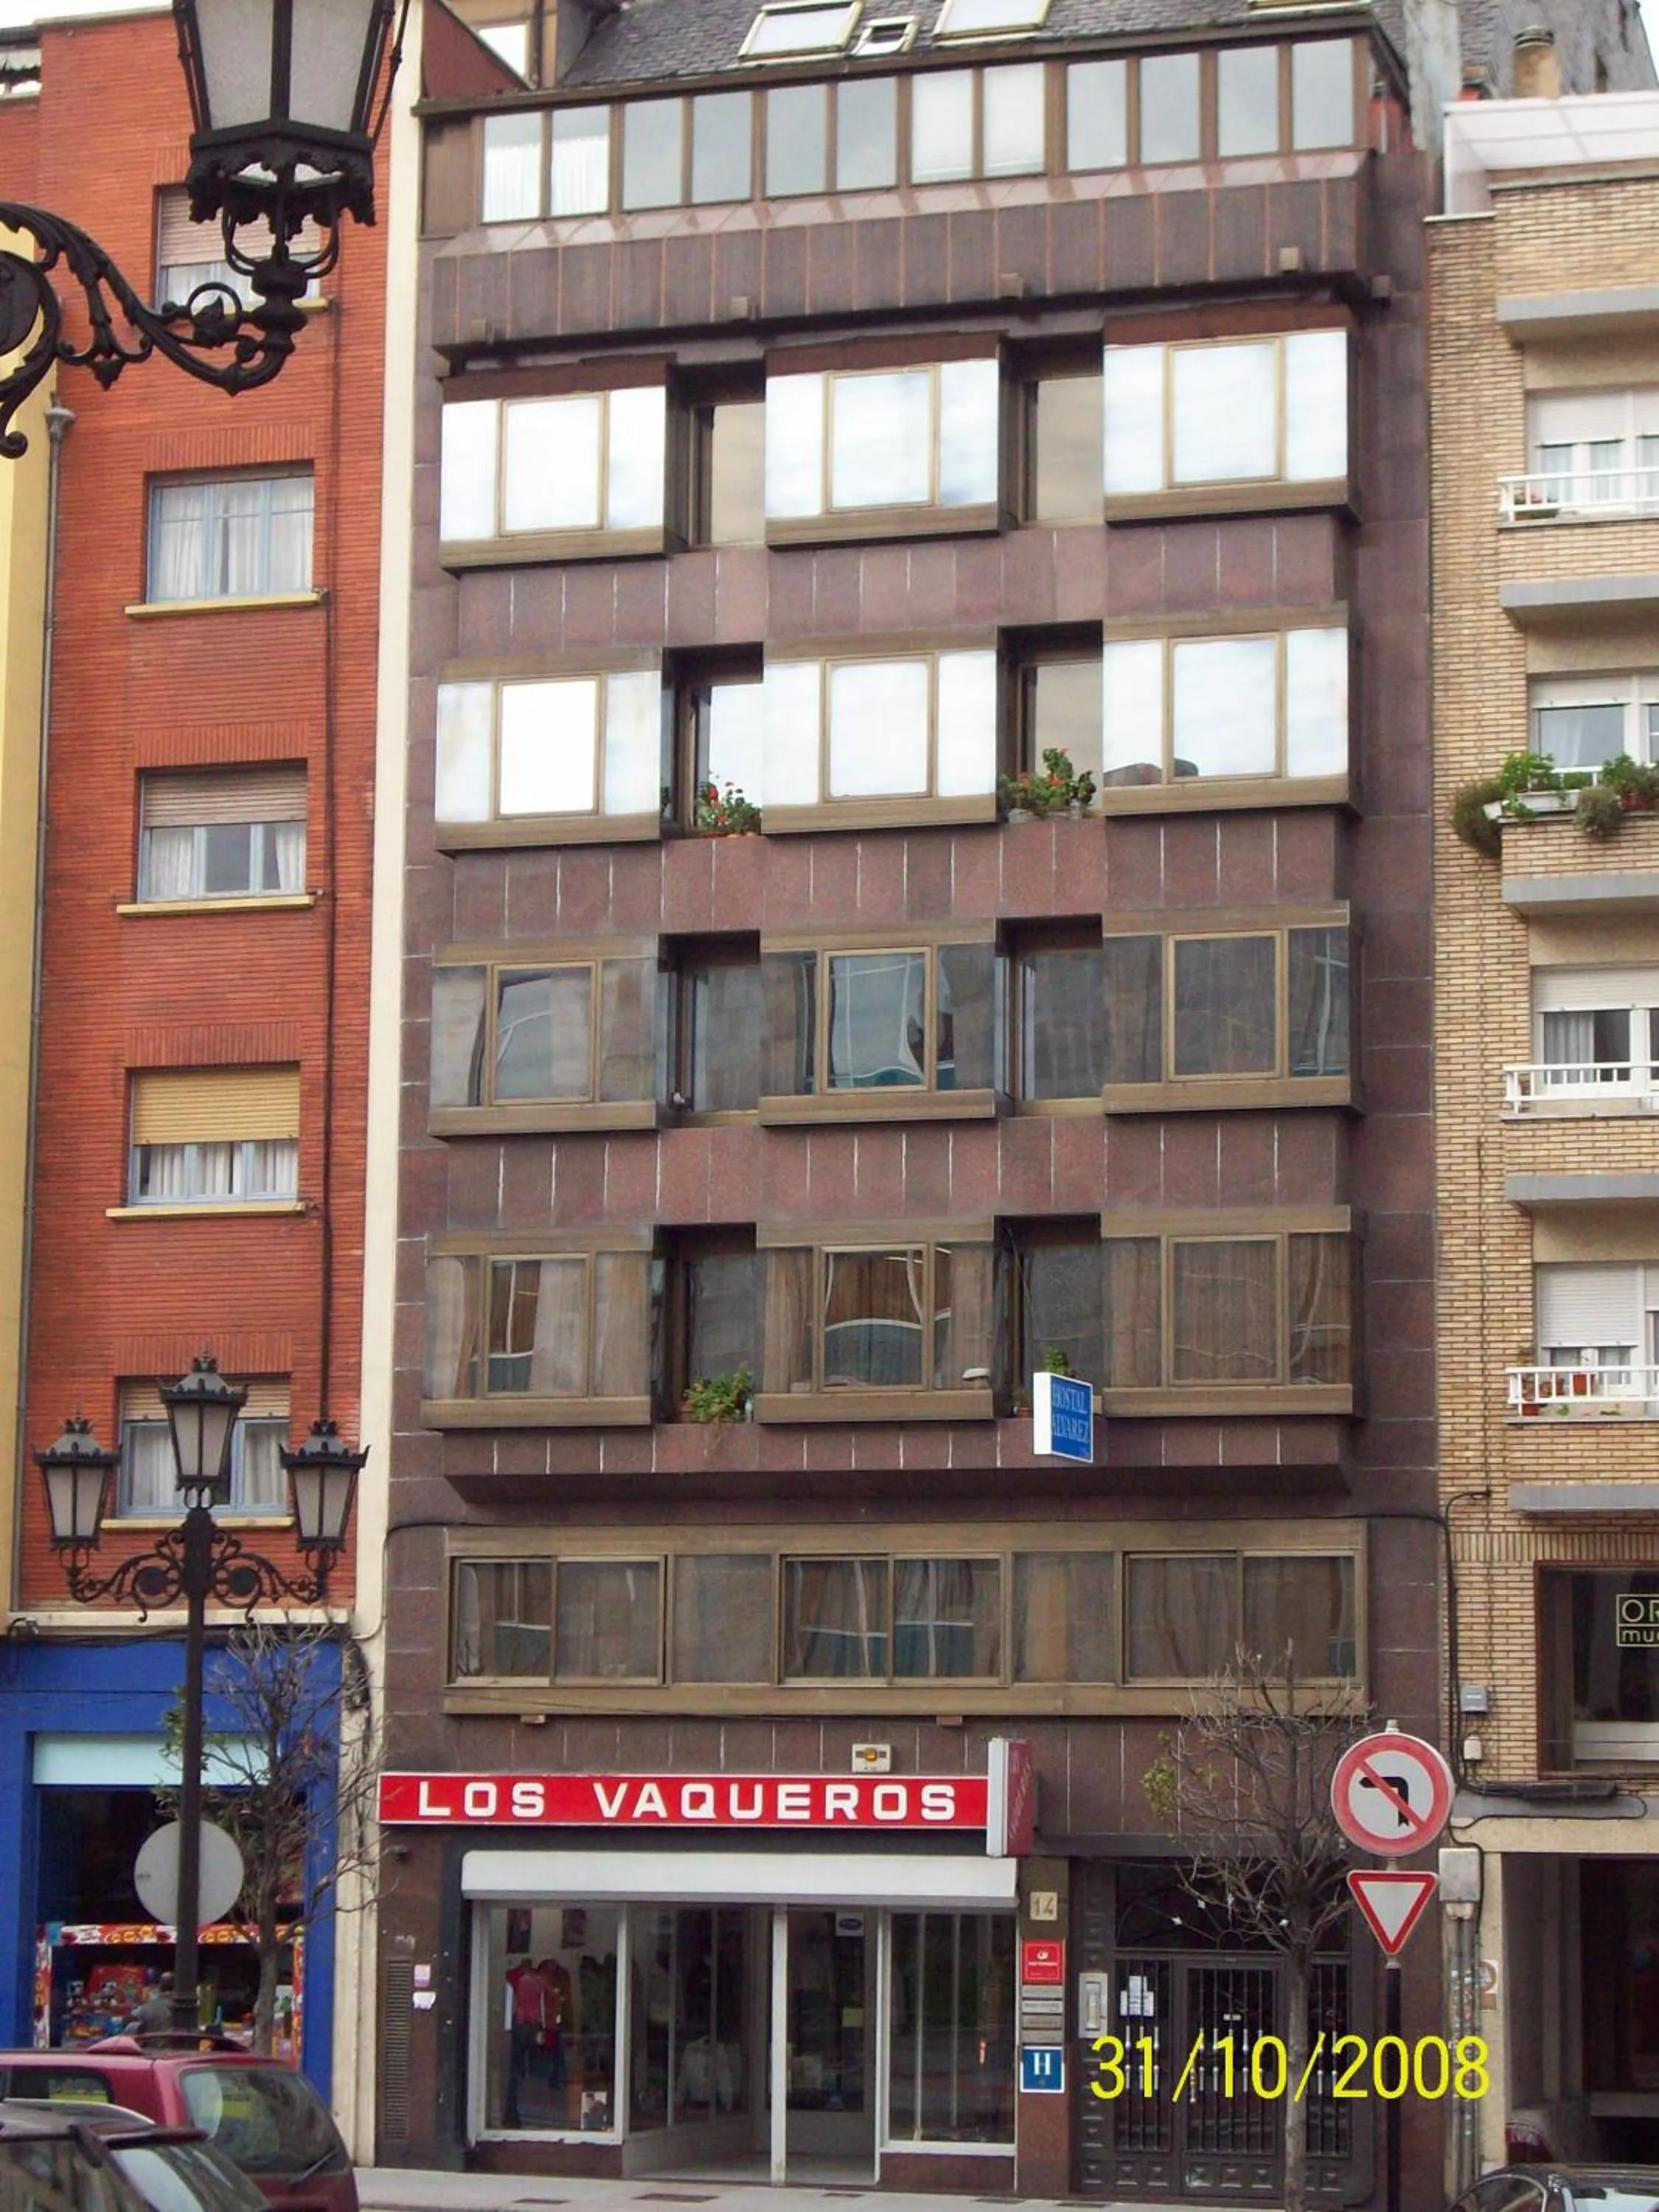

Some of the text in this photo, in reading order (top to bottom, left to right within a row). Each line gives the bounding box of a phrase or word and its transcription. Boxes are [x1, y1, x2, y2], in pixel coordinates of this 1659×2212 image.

[1621, 1630, 1659, 1643] mu
[418, 1781, 956, 1820] LOS VAQUEROS
[1032, 1896, 1054, 1918] 14
[1034, 2052, 1051, 2076] H
